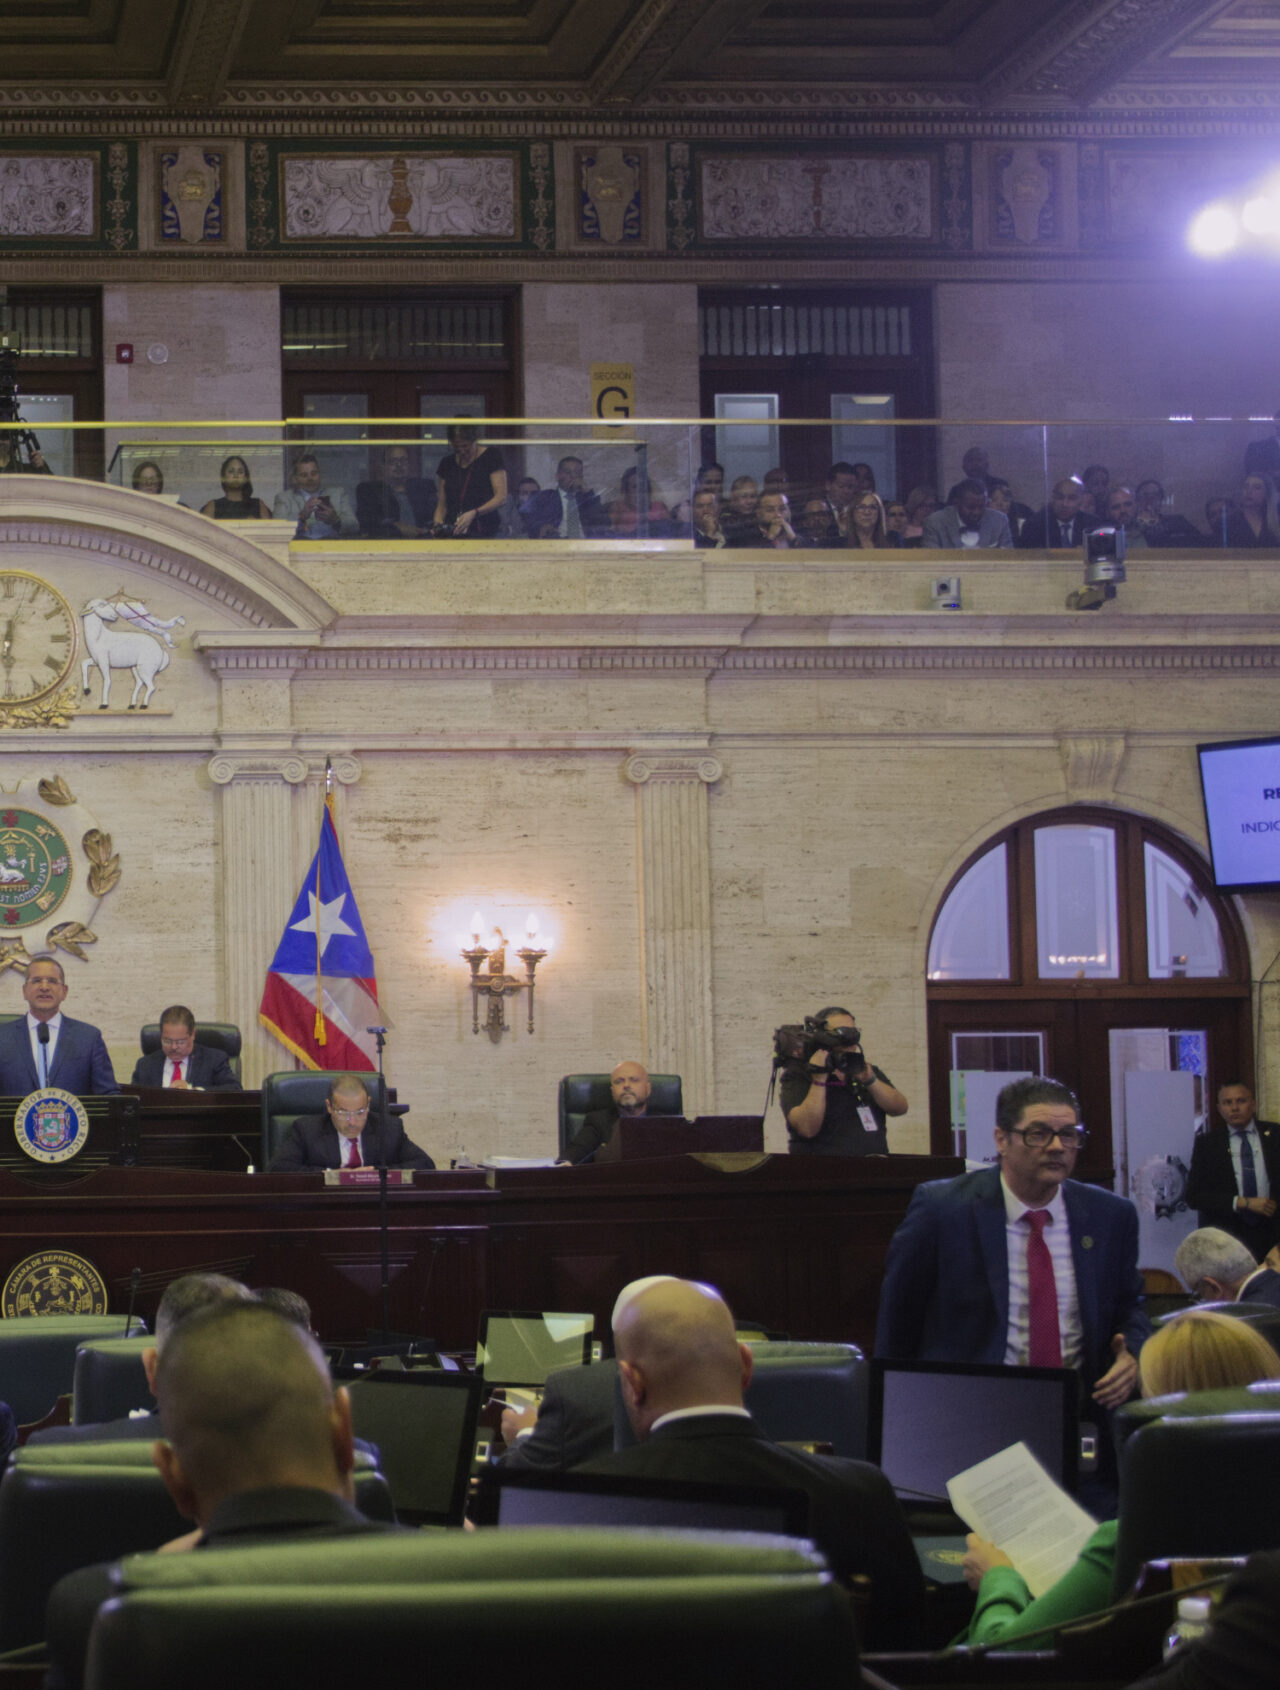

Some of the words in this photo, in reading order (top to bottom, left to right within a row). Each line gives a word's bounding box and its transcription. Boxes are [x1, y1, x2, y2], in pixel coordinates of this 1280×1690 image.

[597, 386, 629, 428] G
[16, 1093, 42, 1154] GOBERNADOR
[61, 1092, 87, 1126] PUERTO
[67, 1132, 86, 1154] RICO
[31, 1258, 42, 1267] DE
[42, 1255, 101, 1293] REPRESENTANTES
